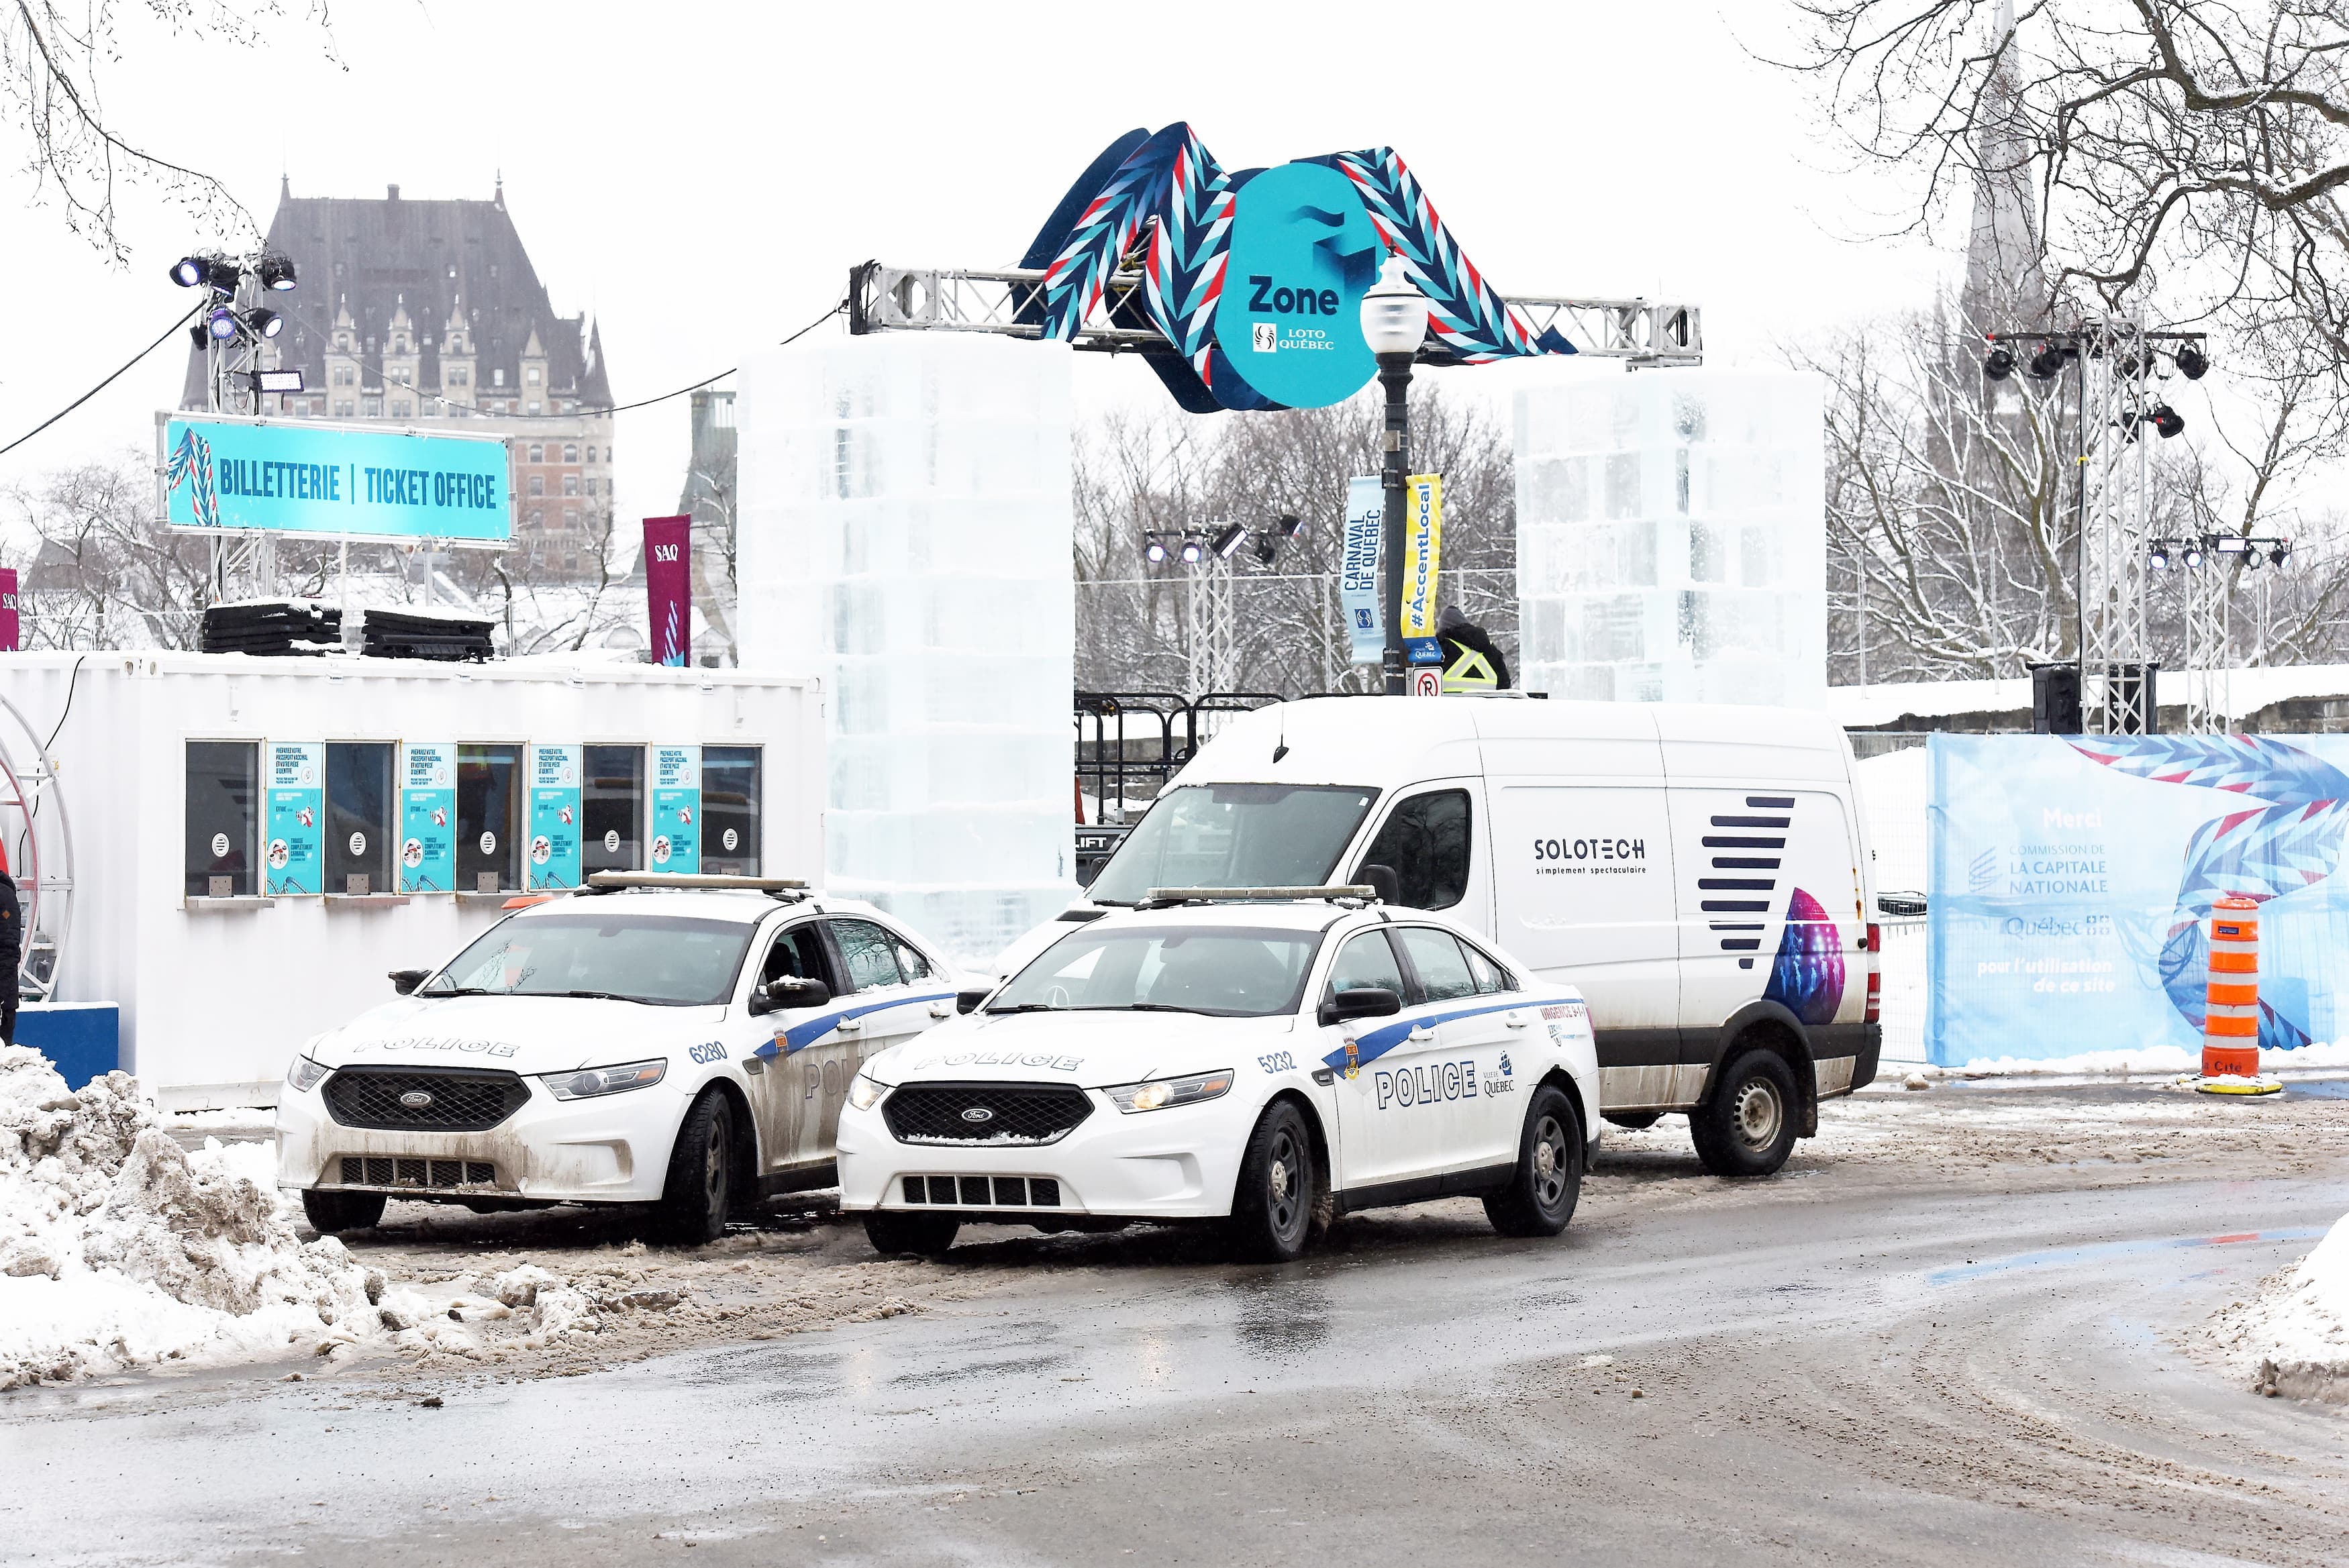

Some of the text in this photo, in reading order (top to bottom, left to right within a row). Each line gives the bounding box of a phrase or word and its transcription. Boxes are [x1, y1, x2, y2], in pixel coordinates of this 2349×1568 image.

[1249, 275, 1339, 315] Zone
[1288, 329, 1326, 338] LOTO
[1279, 339, 1334, 350] QUÉBEC
[219, 458, 340, 501] BILLETTERIE
[364, 467, 497, 509] TICKET OFFICE
[654, 543, 679, 562] SAQ
[1344, 515, 1365, 590] CARNAVAL
[1411, 484, 1430, 627] #AccentLocal
[1359, 572, 1375, 590] DE
[2043, 806, 2102, 828] Merci
[1075, 837, 1107, 847] IFT
[1534, 839, 1645, 859] SOLOTECH
[2009, 844, 2105, 855] COMMISSION DE
[1536, 866, 1646, 875] simplement spectaculaire
[2010, 860, 2107, 874] LA CAPITALE
[2009, 880, 2109, 894] NATIONALE
[2007, 916, 2083, 939] Québec
[1978, 961, 2011, 978] pour
[2033, 977, 2115, 992] de ce site
[1540, 1006, 1573, 1020] URGENCE
[353, 1037, 520, 1057] POLICE
[689, 1041, 728, 1064] 6280
[914, 1052, 1085, 1071] POLICE
[1257, 1051, 1297, 1074] 5232
[1375, 1060, 1477, 1110] POLICE
[1484, 1078, 1515, 1098] QUÉBEC
[968, 1110, 985, 1119] Ford
